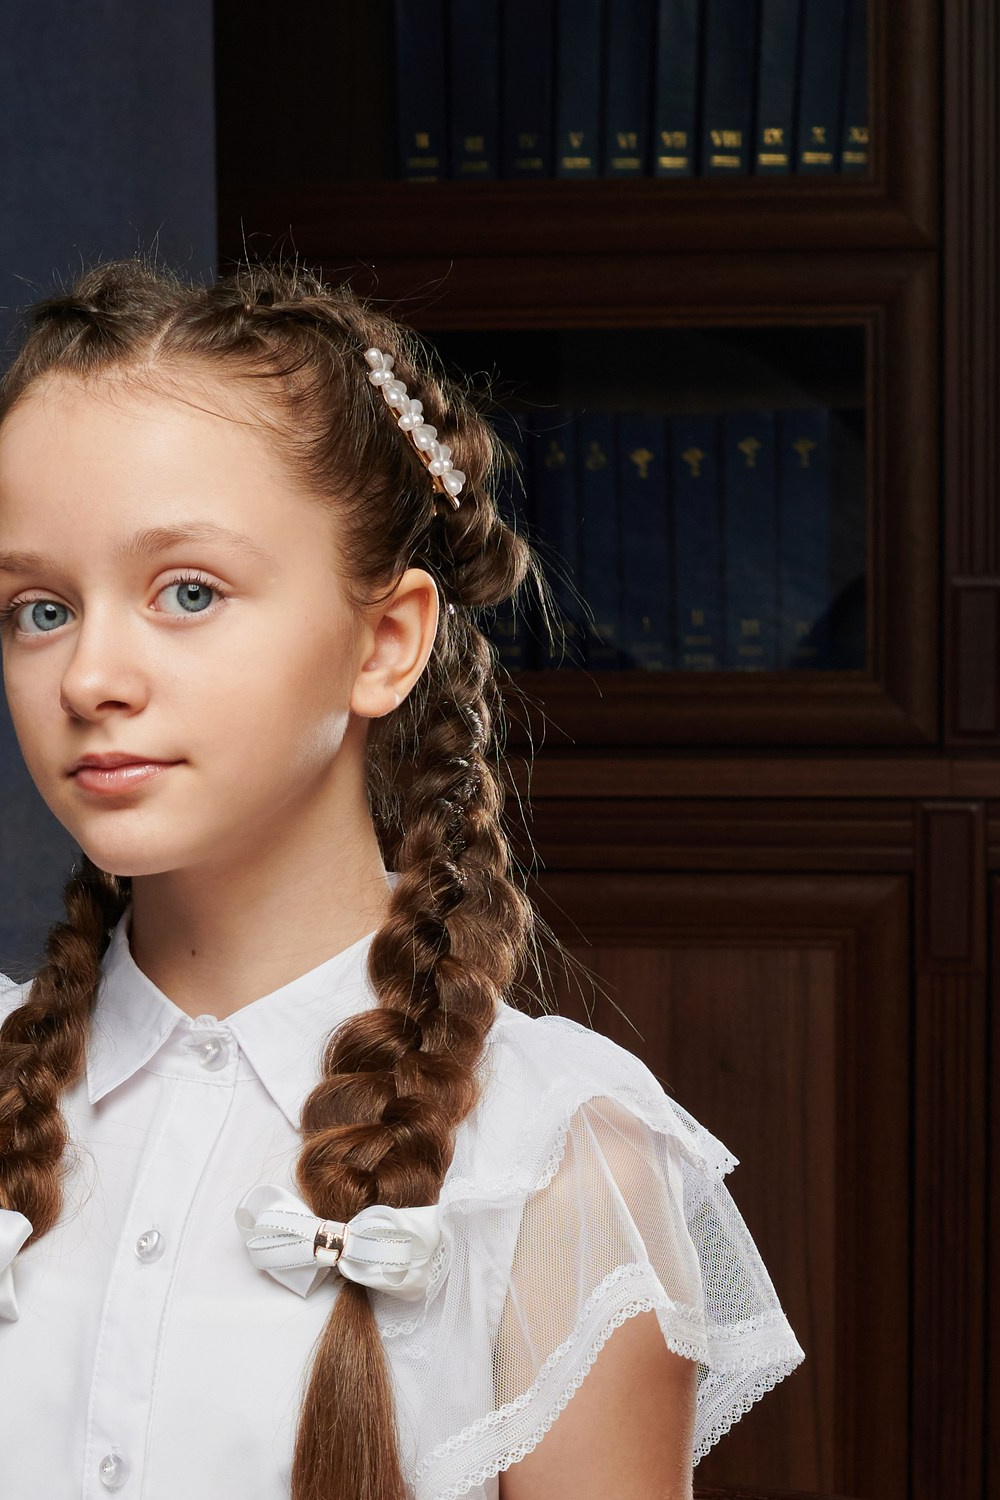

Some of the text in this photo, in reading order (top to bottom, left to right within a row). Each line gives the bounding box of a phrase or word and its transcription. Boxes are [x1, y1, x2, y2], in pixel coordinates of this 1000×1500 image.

[569, 131, 585, 149] V
[616, 132, 638, 149] VI
[660, 131, 688, 149] VII
[709, 130, 743, 149] VIII
[763, 127, 784, 146] IX
[811, 126, 826, 144] X
